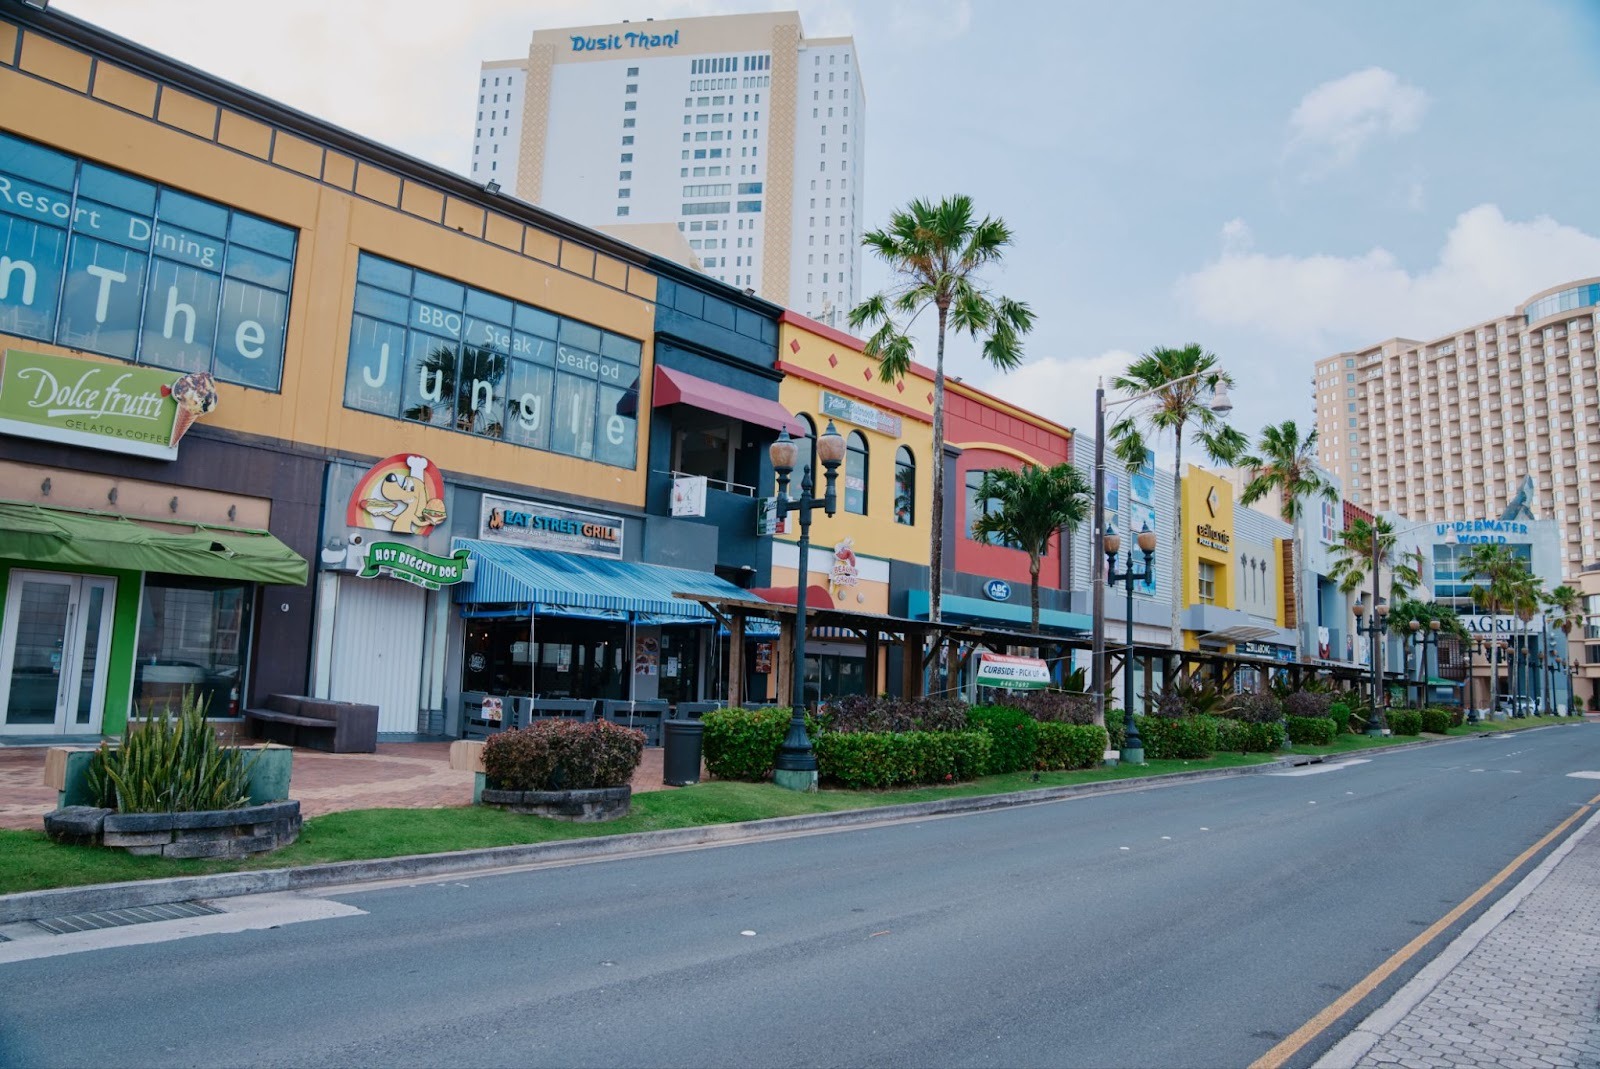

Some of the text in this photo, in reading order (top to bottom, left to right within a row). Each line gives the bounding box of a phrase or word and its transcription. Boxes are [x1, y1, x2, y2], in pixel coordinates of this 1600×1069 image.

[570, 29, 679, 51] Dusit Thani
[128, 217, 216, 267] Dining
[86, 264, 266, 359] The
[557, 346, 620, 380] Seafood
[17, 367, 165, 419] Dolce frutti
[65, 419, 170, 444] GELATO & COFFEE
[503, 509, 617, 541] EAT STREET GRILL
[1456, 534, 1507, 545] WORLD
[375, 549, 457, 578] HOT DIGGETY DOG
[990, 583, 1007, 593] ABC
[983, 665, 1015, 676] CURBSIDE
[1018, 668, 1032, 677] PICK
